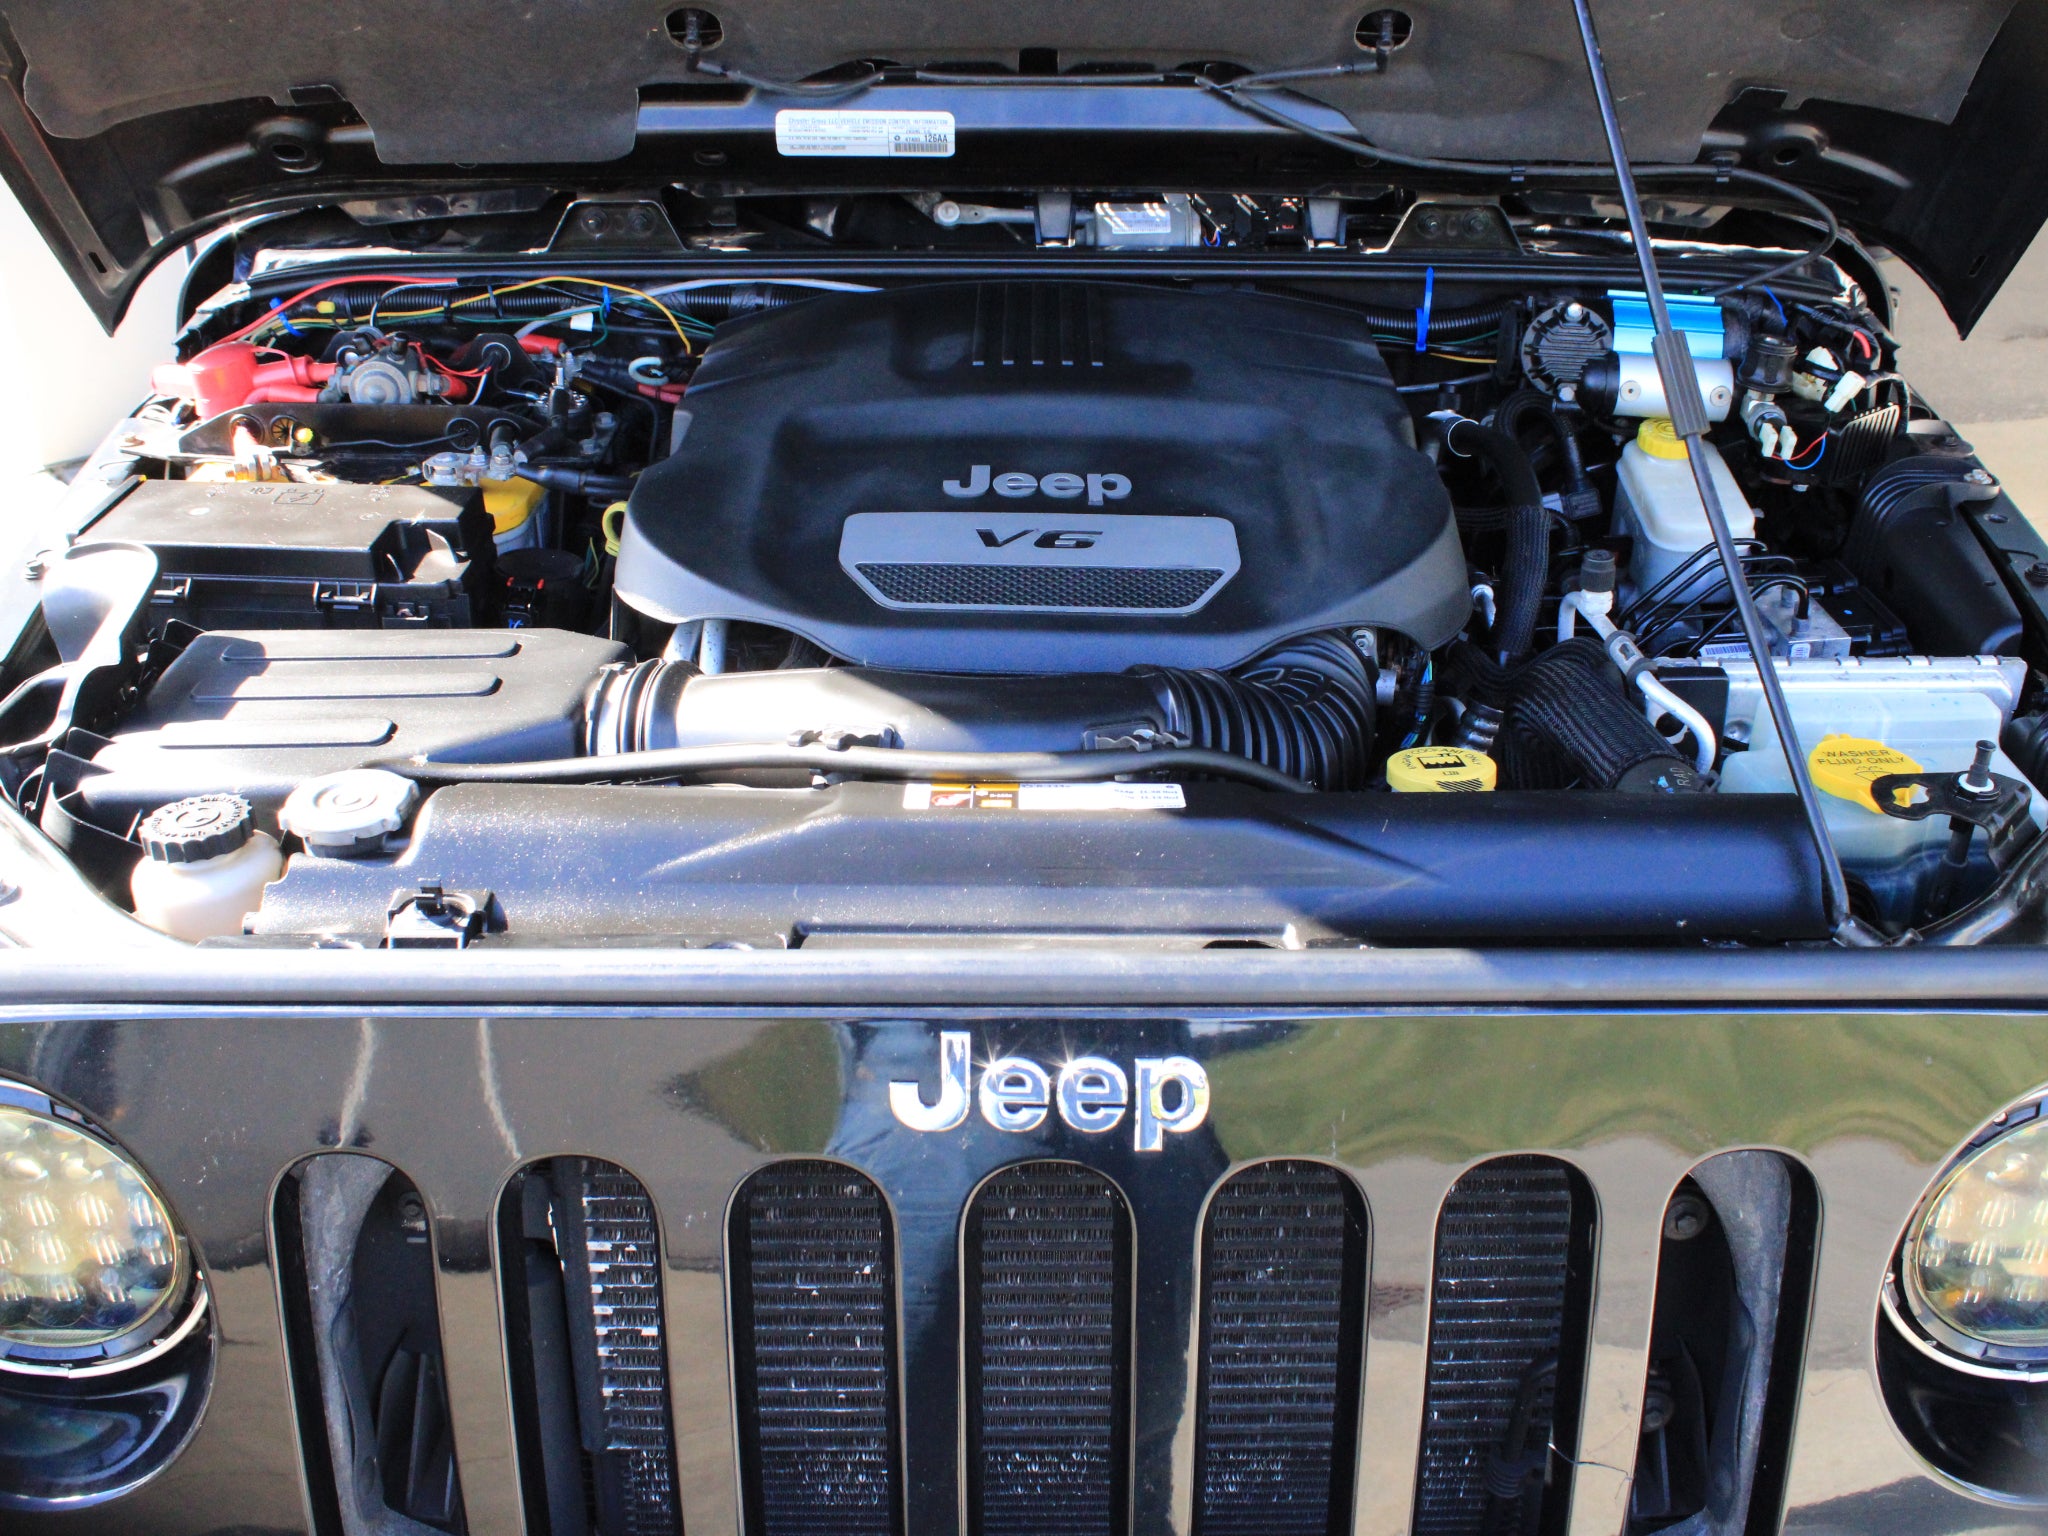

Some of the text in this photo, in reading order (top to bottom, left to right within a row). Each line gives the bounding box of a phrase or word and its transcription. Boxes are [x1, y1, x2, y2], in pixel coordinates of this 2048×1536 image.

[924, 134, 948, 143] 126AA
[942, 464, 1132, 506] Jeep
[975, 527, 1104, 549] V6
[1817, 756, 1904, 765] FLUID ONLY
[1822, 749, 1890, 758] WASHER
[889, 1031, 1209, 1152] Jeep
